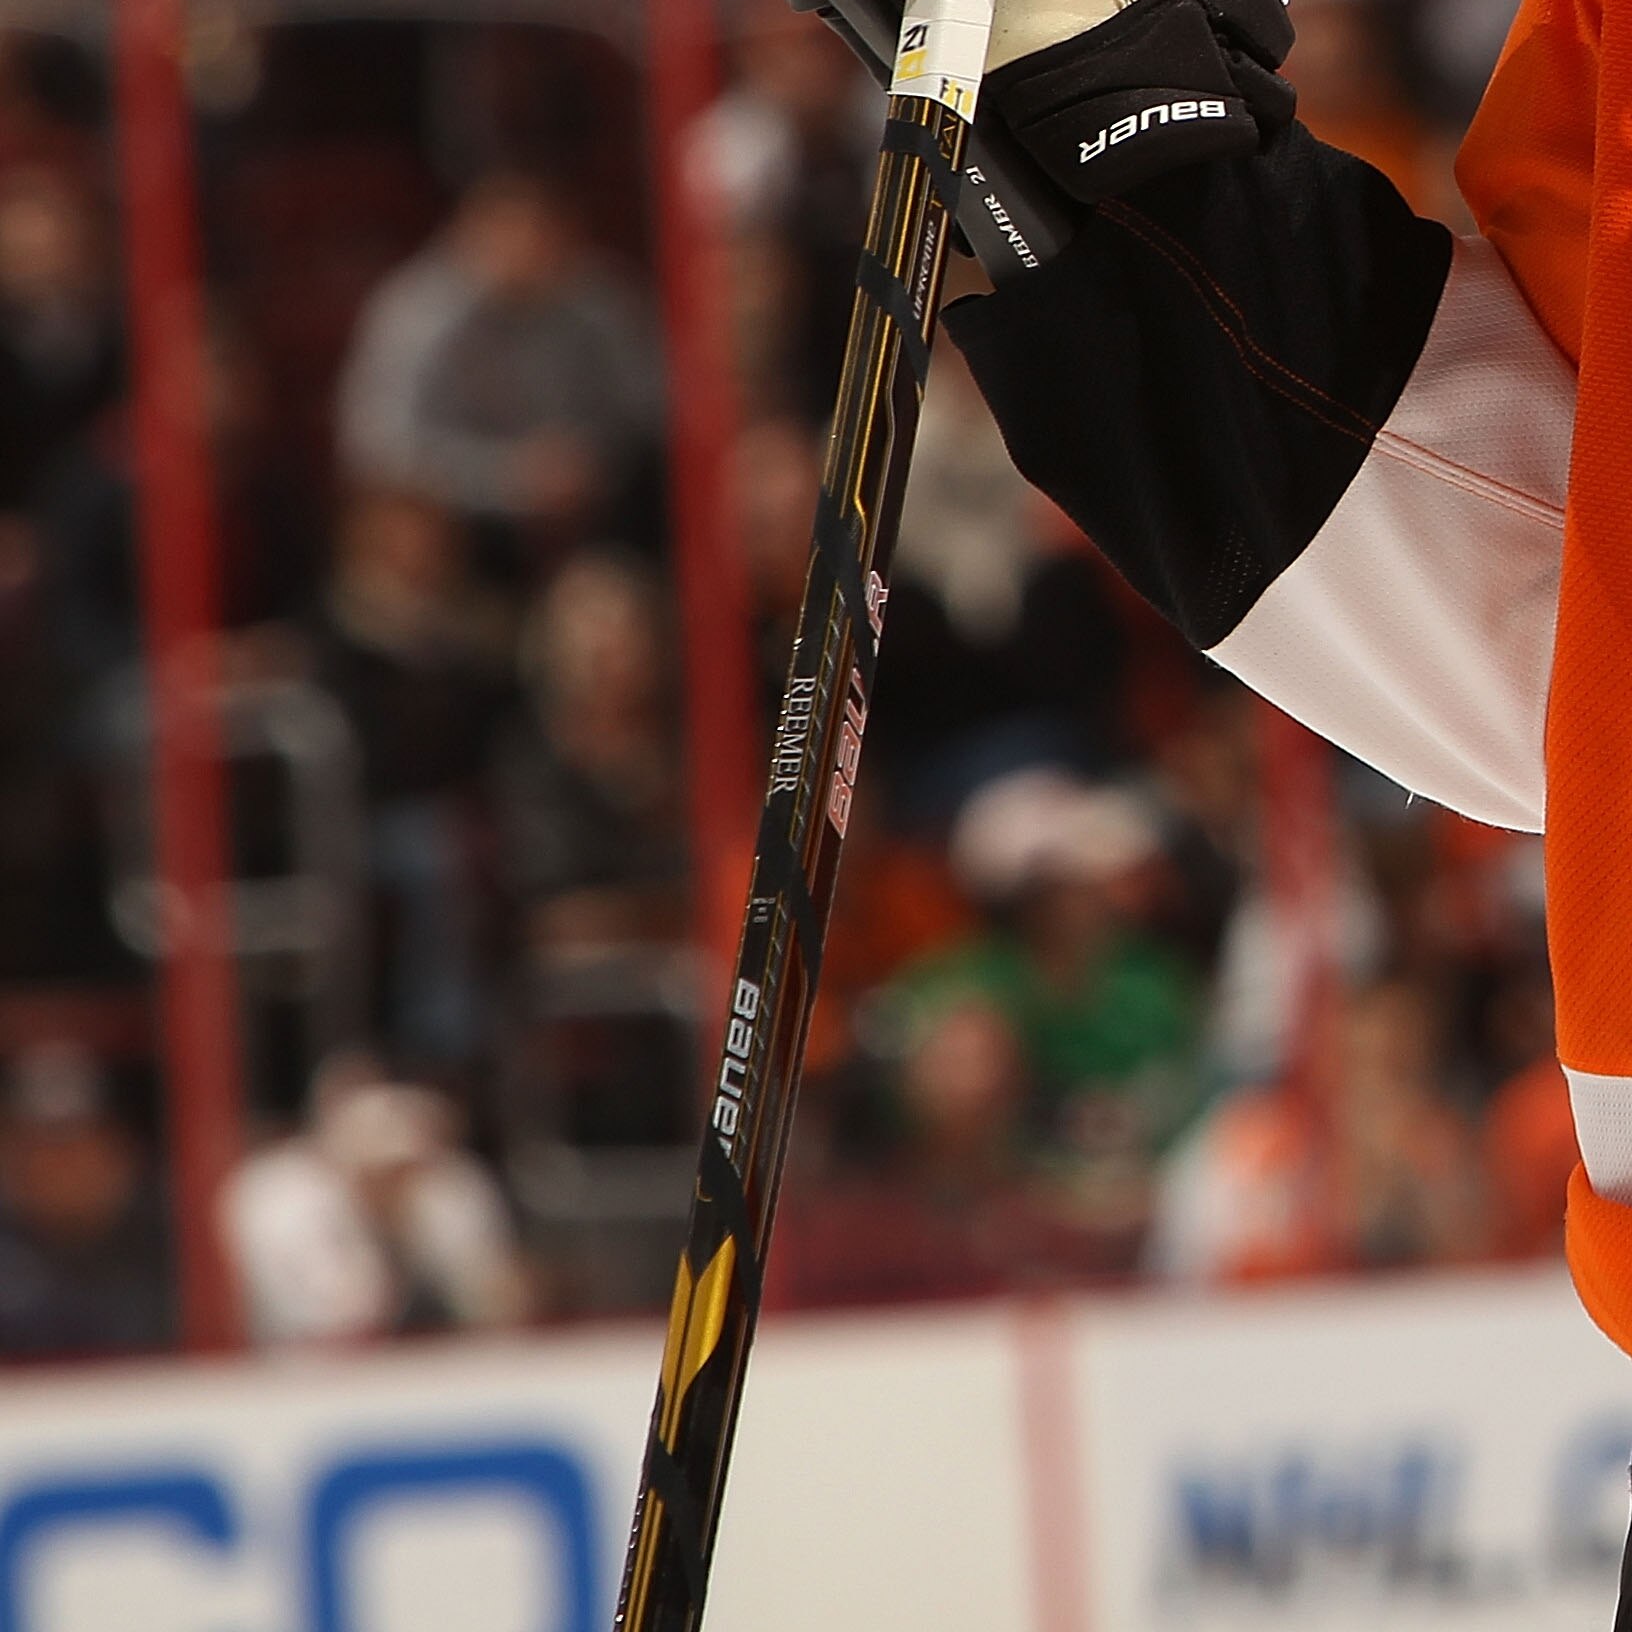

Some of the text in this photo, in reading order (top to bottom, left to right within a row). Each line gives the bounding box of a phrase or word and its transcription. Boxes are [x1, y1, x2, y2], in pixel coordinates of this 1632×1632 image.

[965, 165, 986, 186] 21
[1077, 99, 1227, 165] BAUER
[772, 674, 817, 794] REEMER
[826, 570, 889, 840] BAUR
